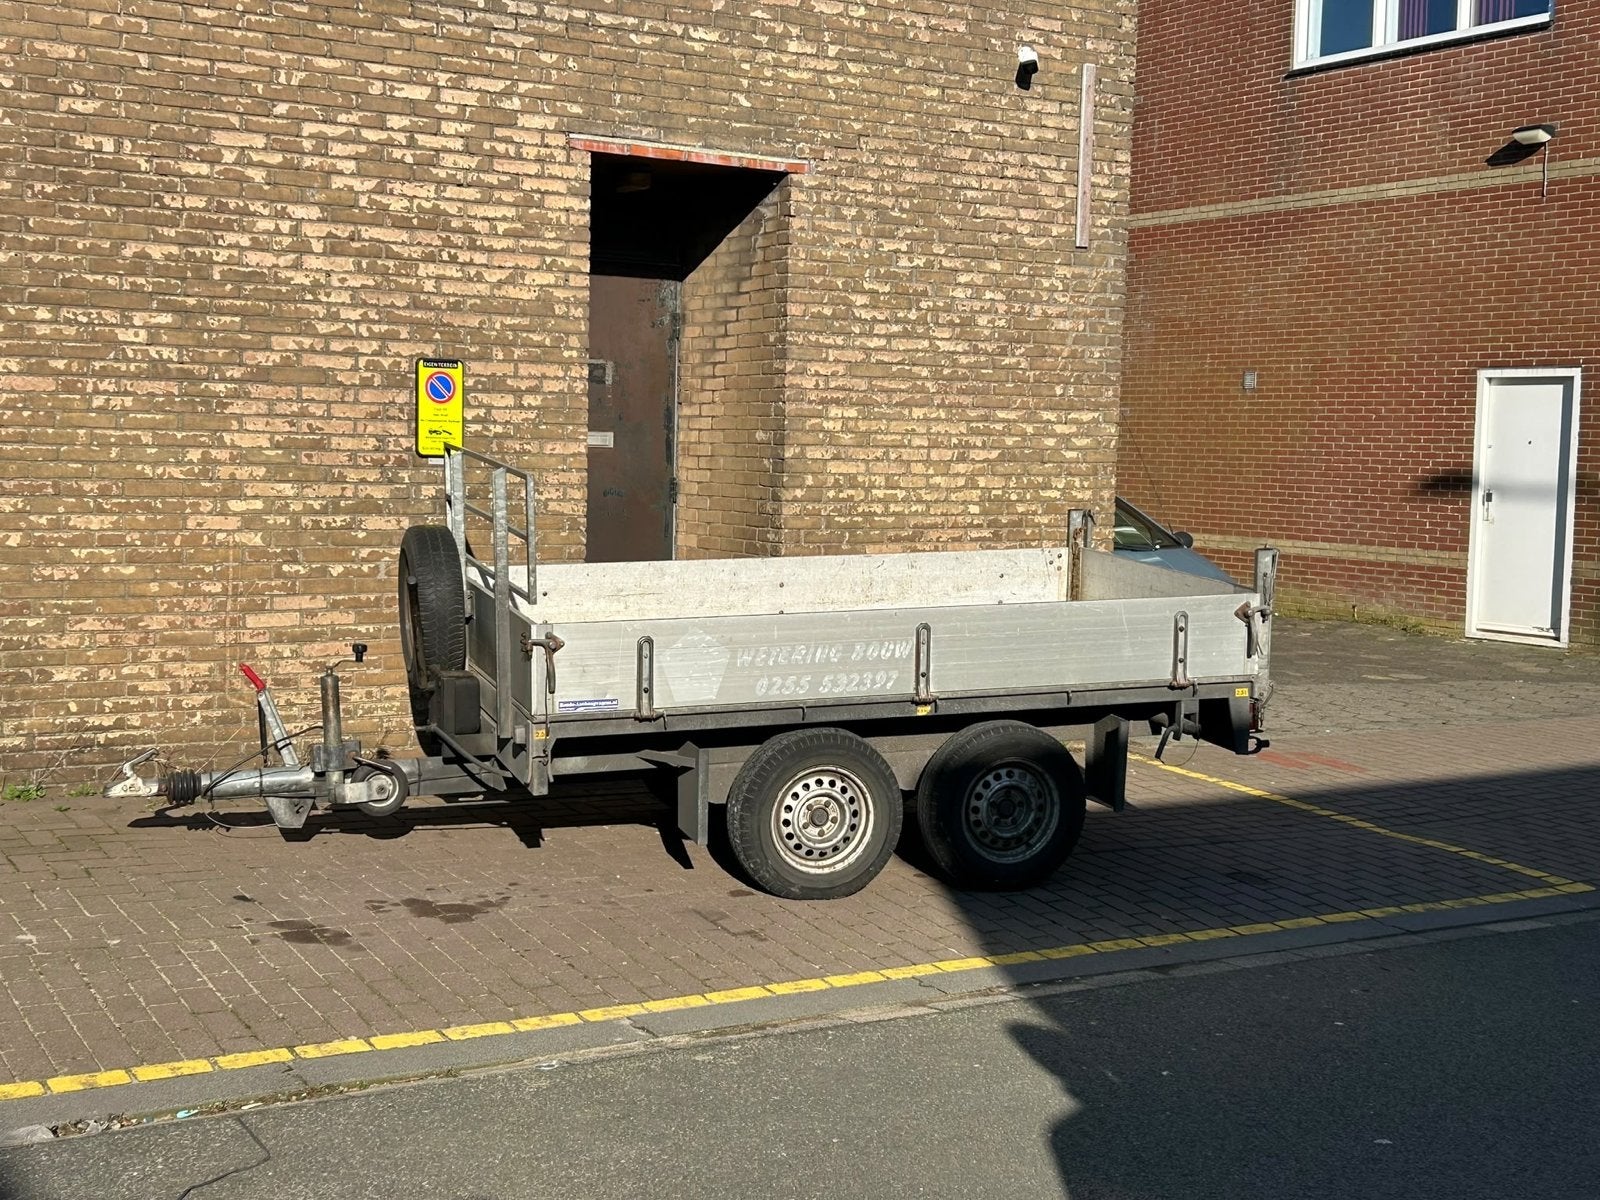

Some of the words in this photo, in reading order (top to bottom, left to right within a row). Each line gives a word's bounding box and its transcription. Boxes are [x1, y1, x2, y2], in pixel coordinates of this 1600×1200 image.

[851, 640, 913, 661] BOUW
[756, 674, 811, 697] 0255
[819, 670, 899, 693] 532397
